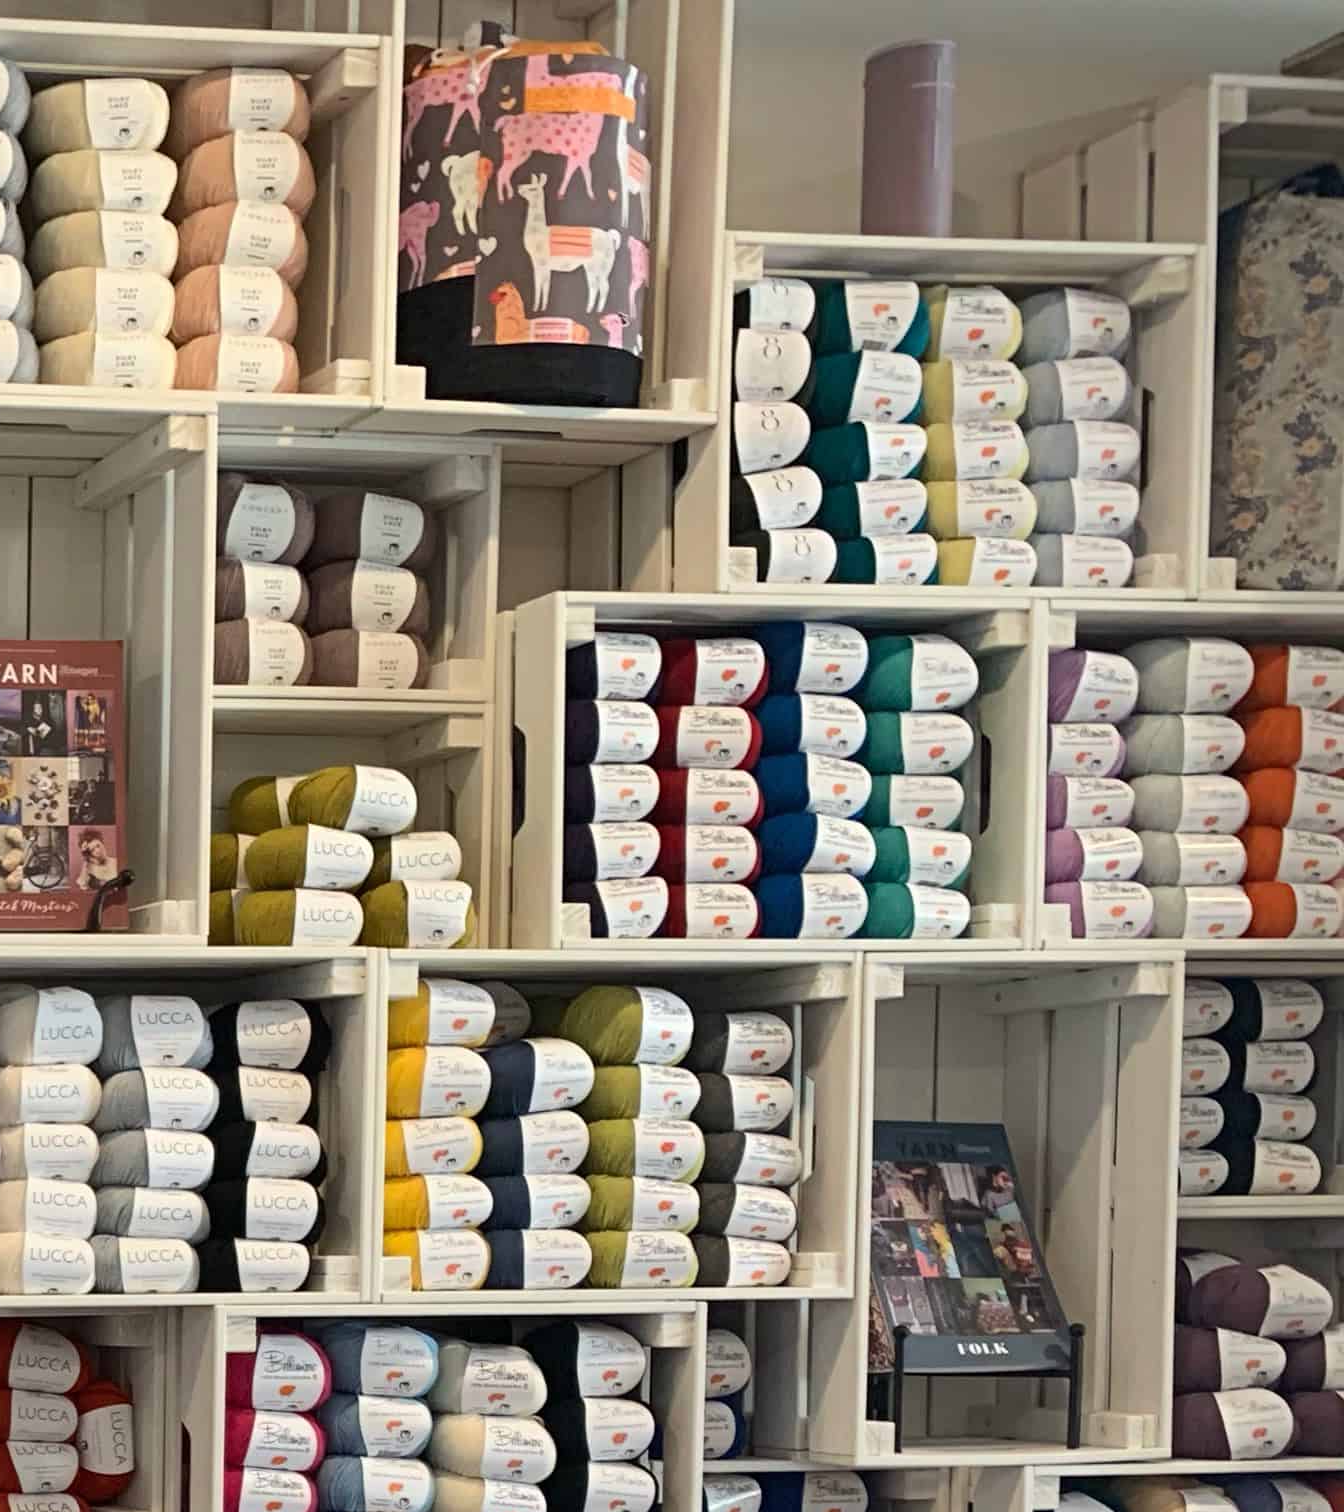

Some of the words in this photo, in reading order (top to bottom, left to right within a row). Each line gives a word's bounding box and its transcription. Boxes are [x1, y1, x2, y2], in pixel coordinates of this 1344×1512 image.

[398, 852, 454, 868] LUCCA
[137, 1012, 194, 1025] LUCCA
[40, 1025, 94, 1040] LUCCA
[256, 1144, 311, 1158] LUCCA
[17, 1356, 72, 1373] LUCCA
[110, 1411, 128, 1466] LUCCA
